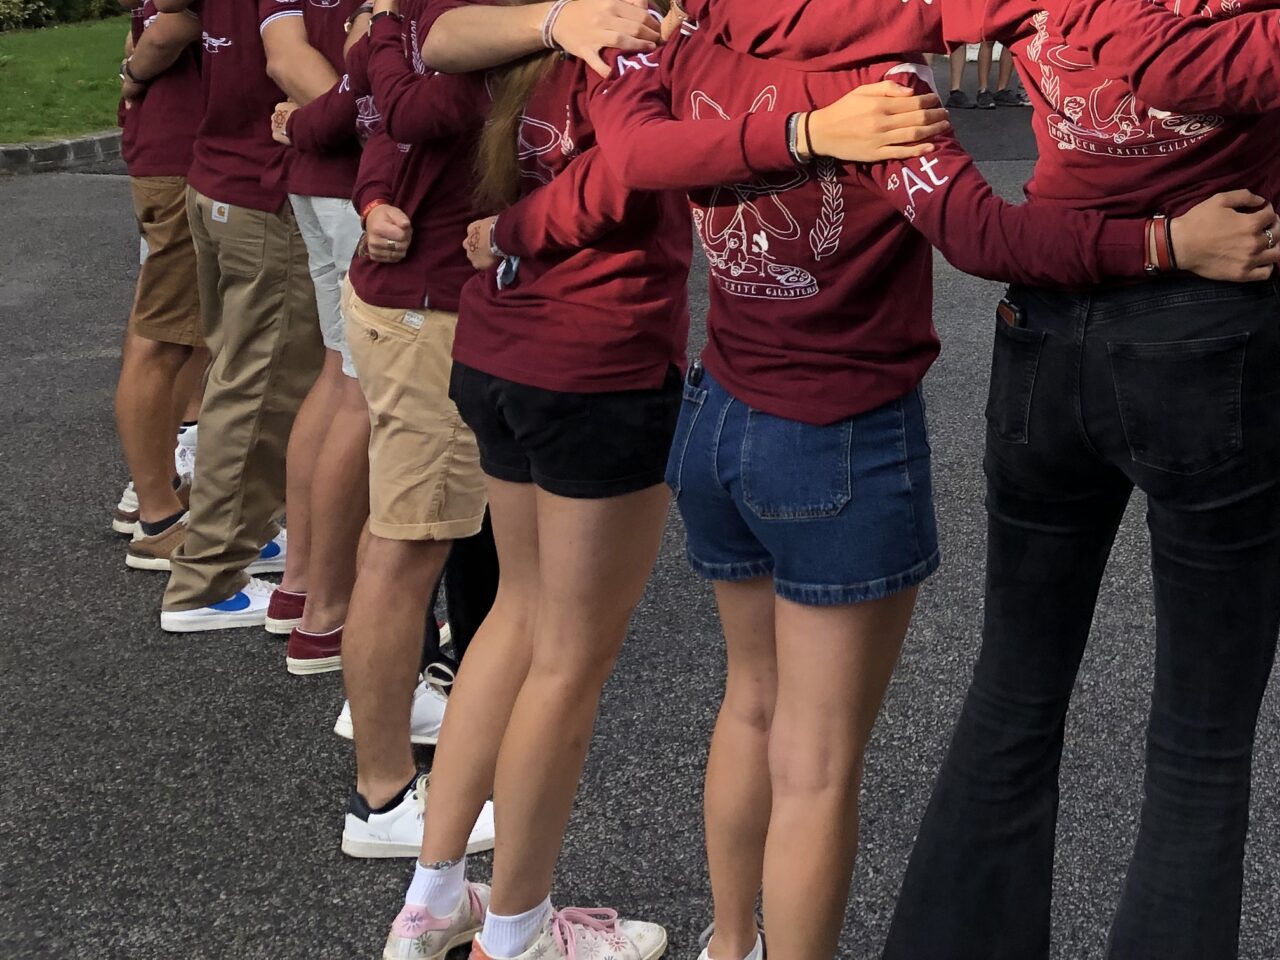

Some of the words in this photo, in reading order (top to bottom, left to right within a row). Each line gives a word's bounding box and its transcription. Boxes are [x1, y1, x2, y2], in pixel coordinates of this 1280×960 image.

[887, 173, 900, 191] 43
[901, 156, 949, 208] At
[903, 204, 916, 223] 13
